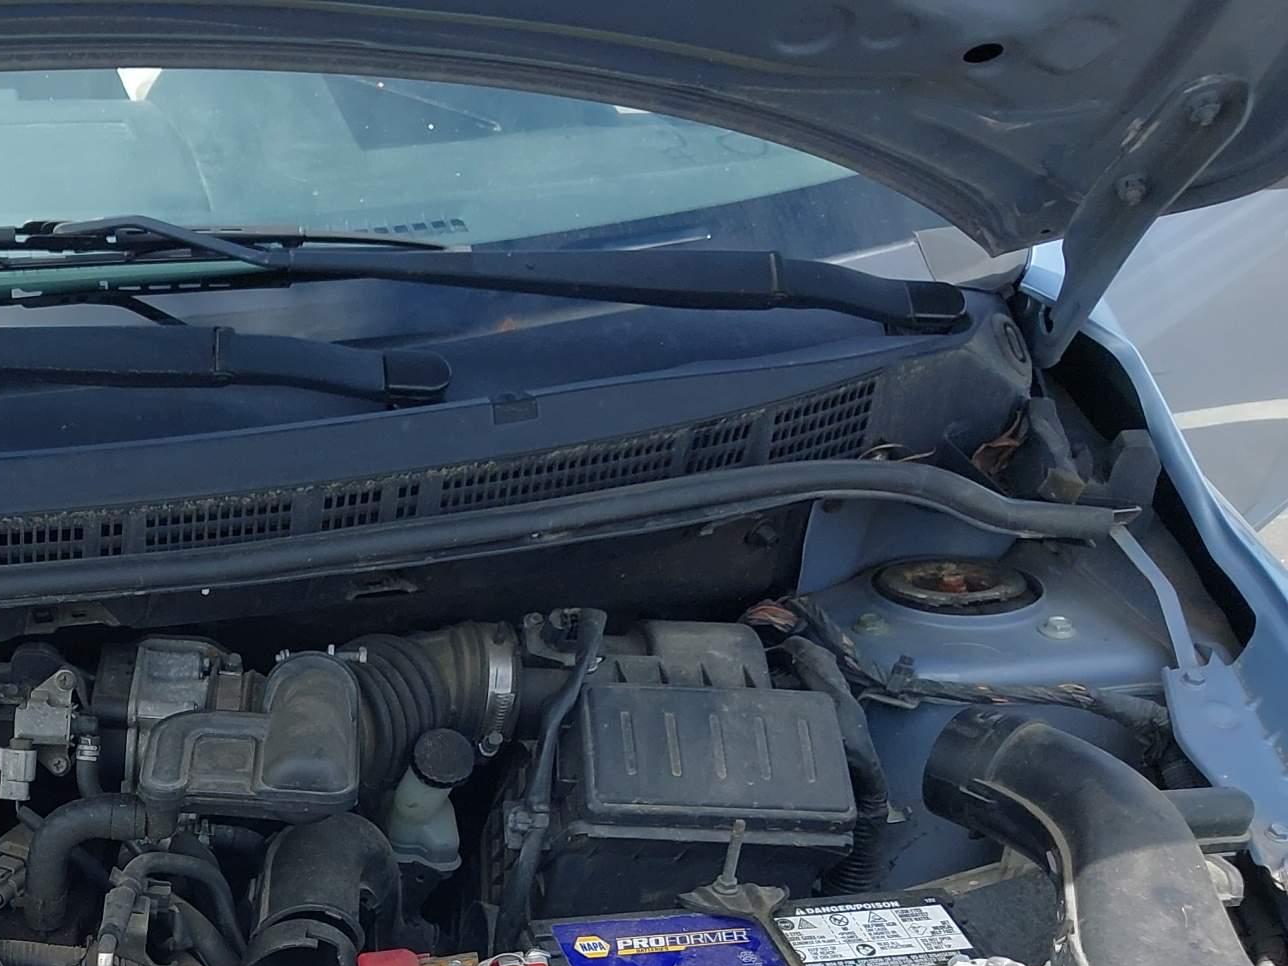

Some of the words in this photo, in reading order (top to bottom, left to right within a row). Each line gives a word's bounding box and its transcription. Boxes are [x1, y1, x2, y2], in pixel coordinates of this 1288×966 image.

[805, 901, 901, 915] DANGER/POISON
[579, 942, 606, 952] NAPA
[617, 930, 749, 949] PROFORMER
